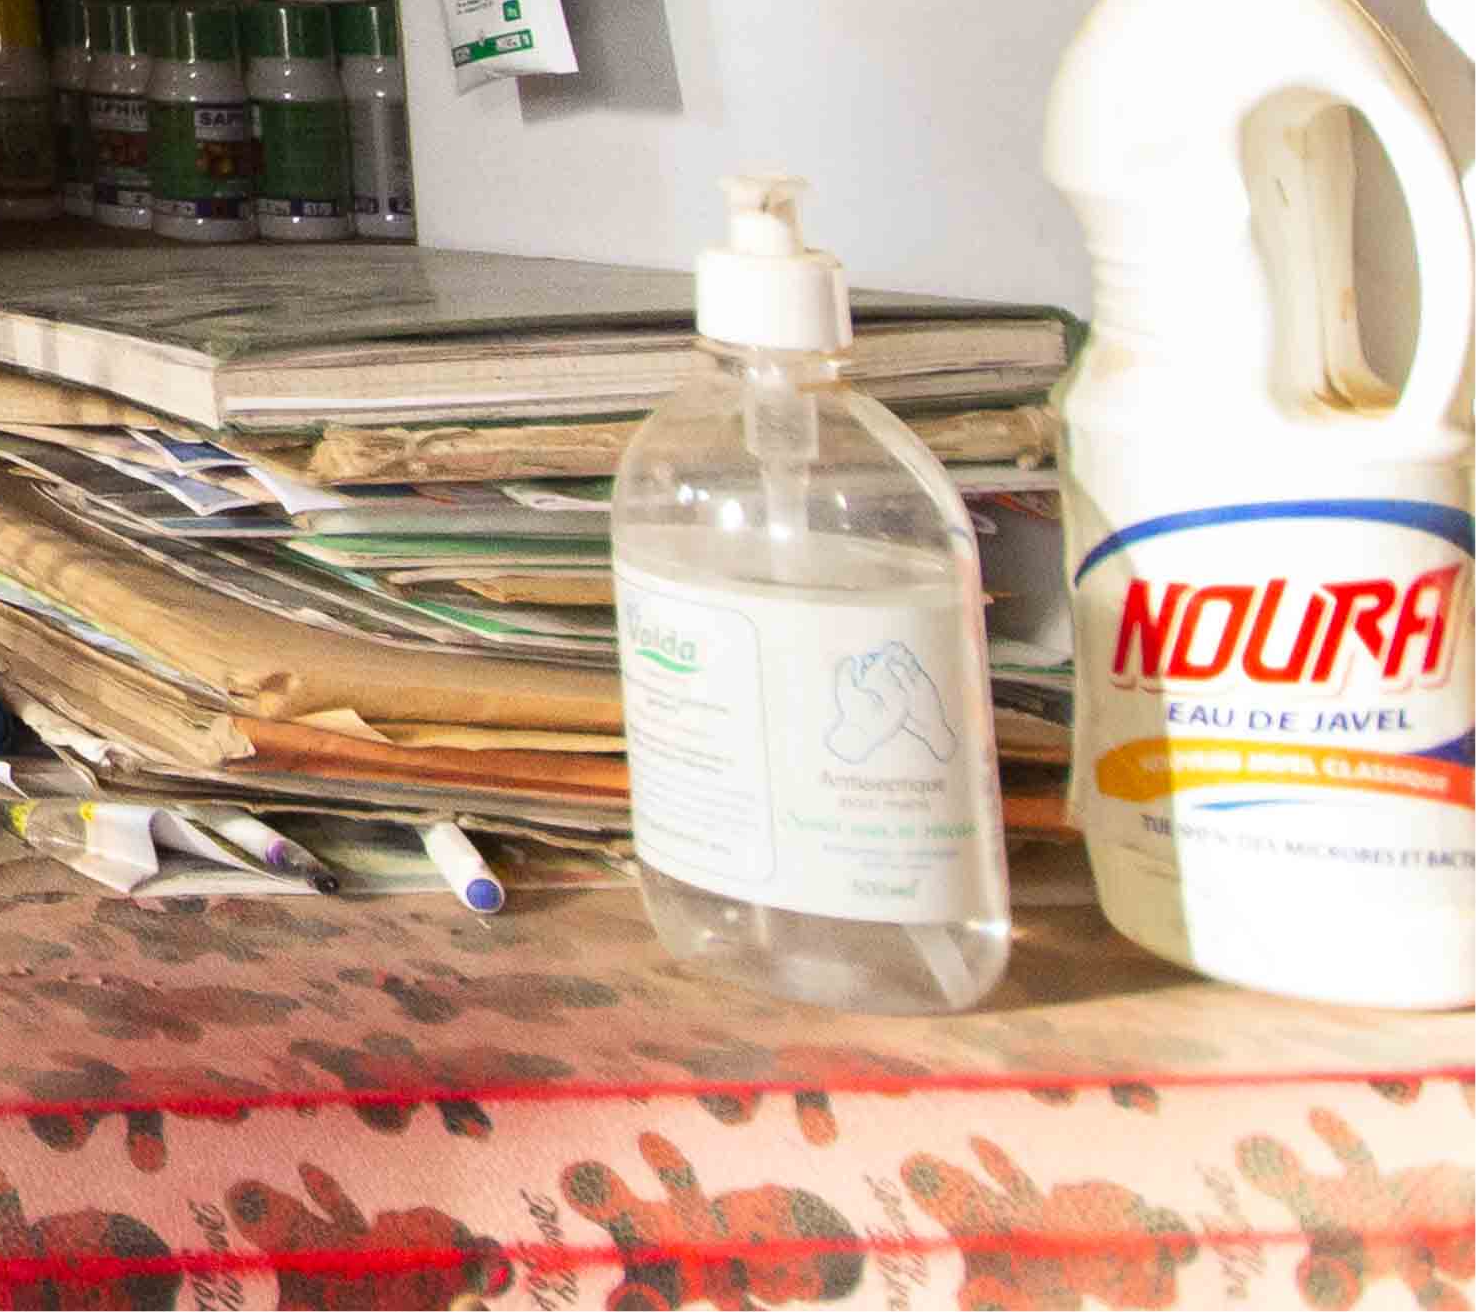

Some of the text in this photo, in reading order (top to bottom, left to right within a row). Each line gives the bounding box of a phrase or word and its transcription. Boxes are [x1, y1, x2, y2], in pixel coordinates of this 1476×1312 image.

[1112, 562, 1465, 684] NOURA
[1167, 701, 1413, 734] EAU DE JAVEL
